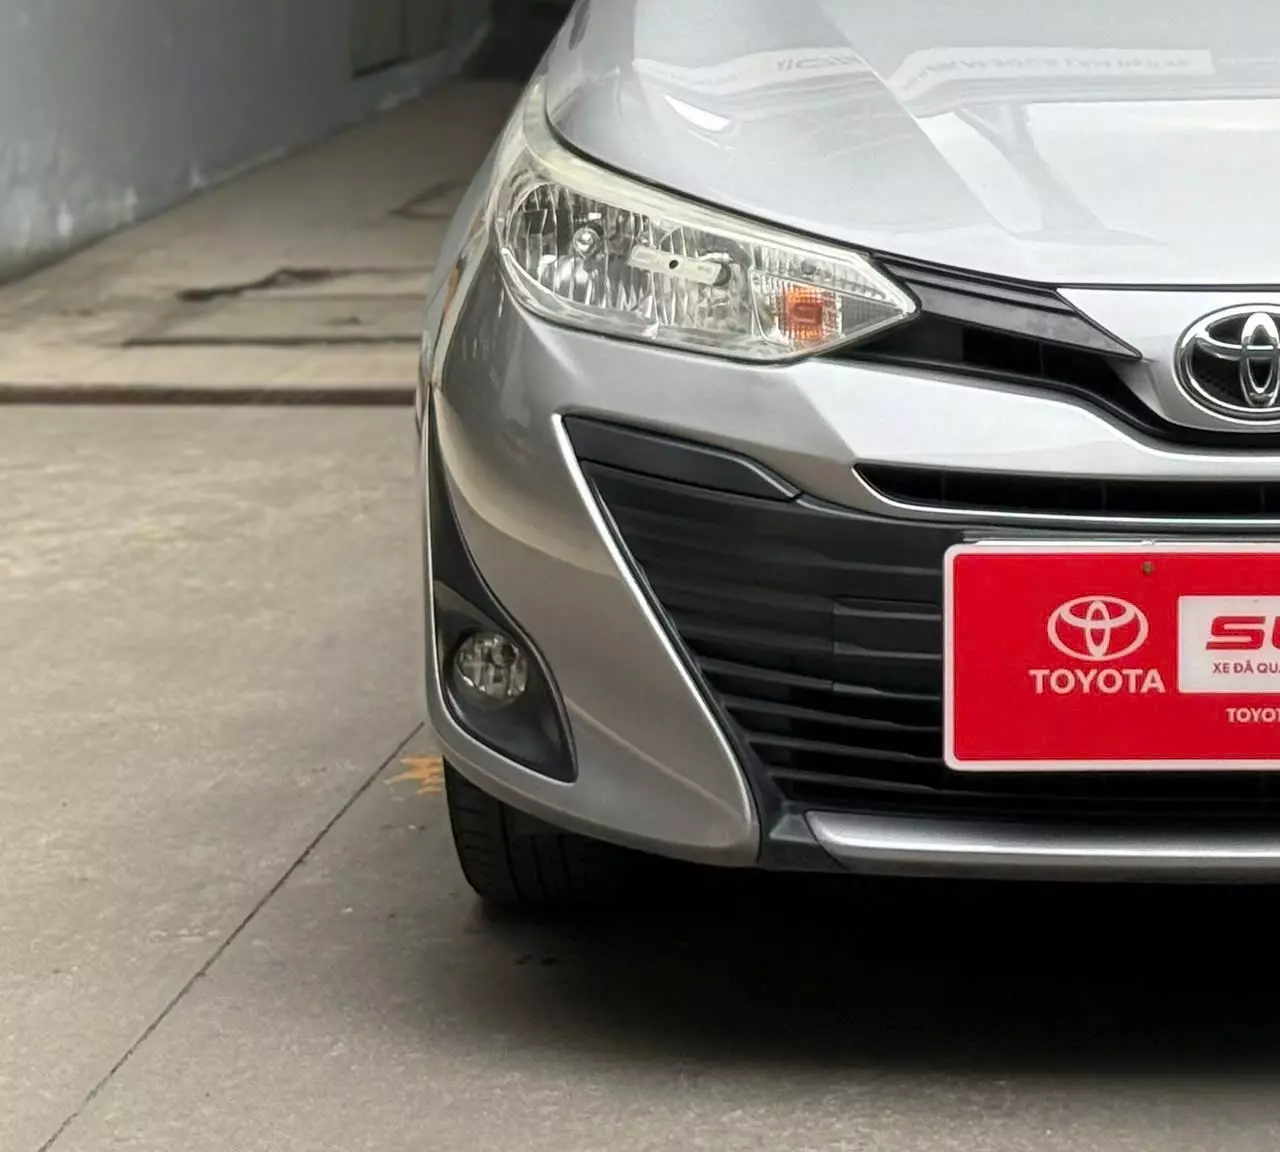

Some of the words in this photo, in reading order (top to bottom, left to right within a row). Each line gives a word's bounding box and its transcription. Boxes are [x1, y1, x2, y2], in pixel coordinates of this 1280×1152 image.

[1212, 662, 1230, 674] XE
[1233, 660, 1255, 674] ĐÃ
[1029, 668, 1165, 694] TOYOTA
